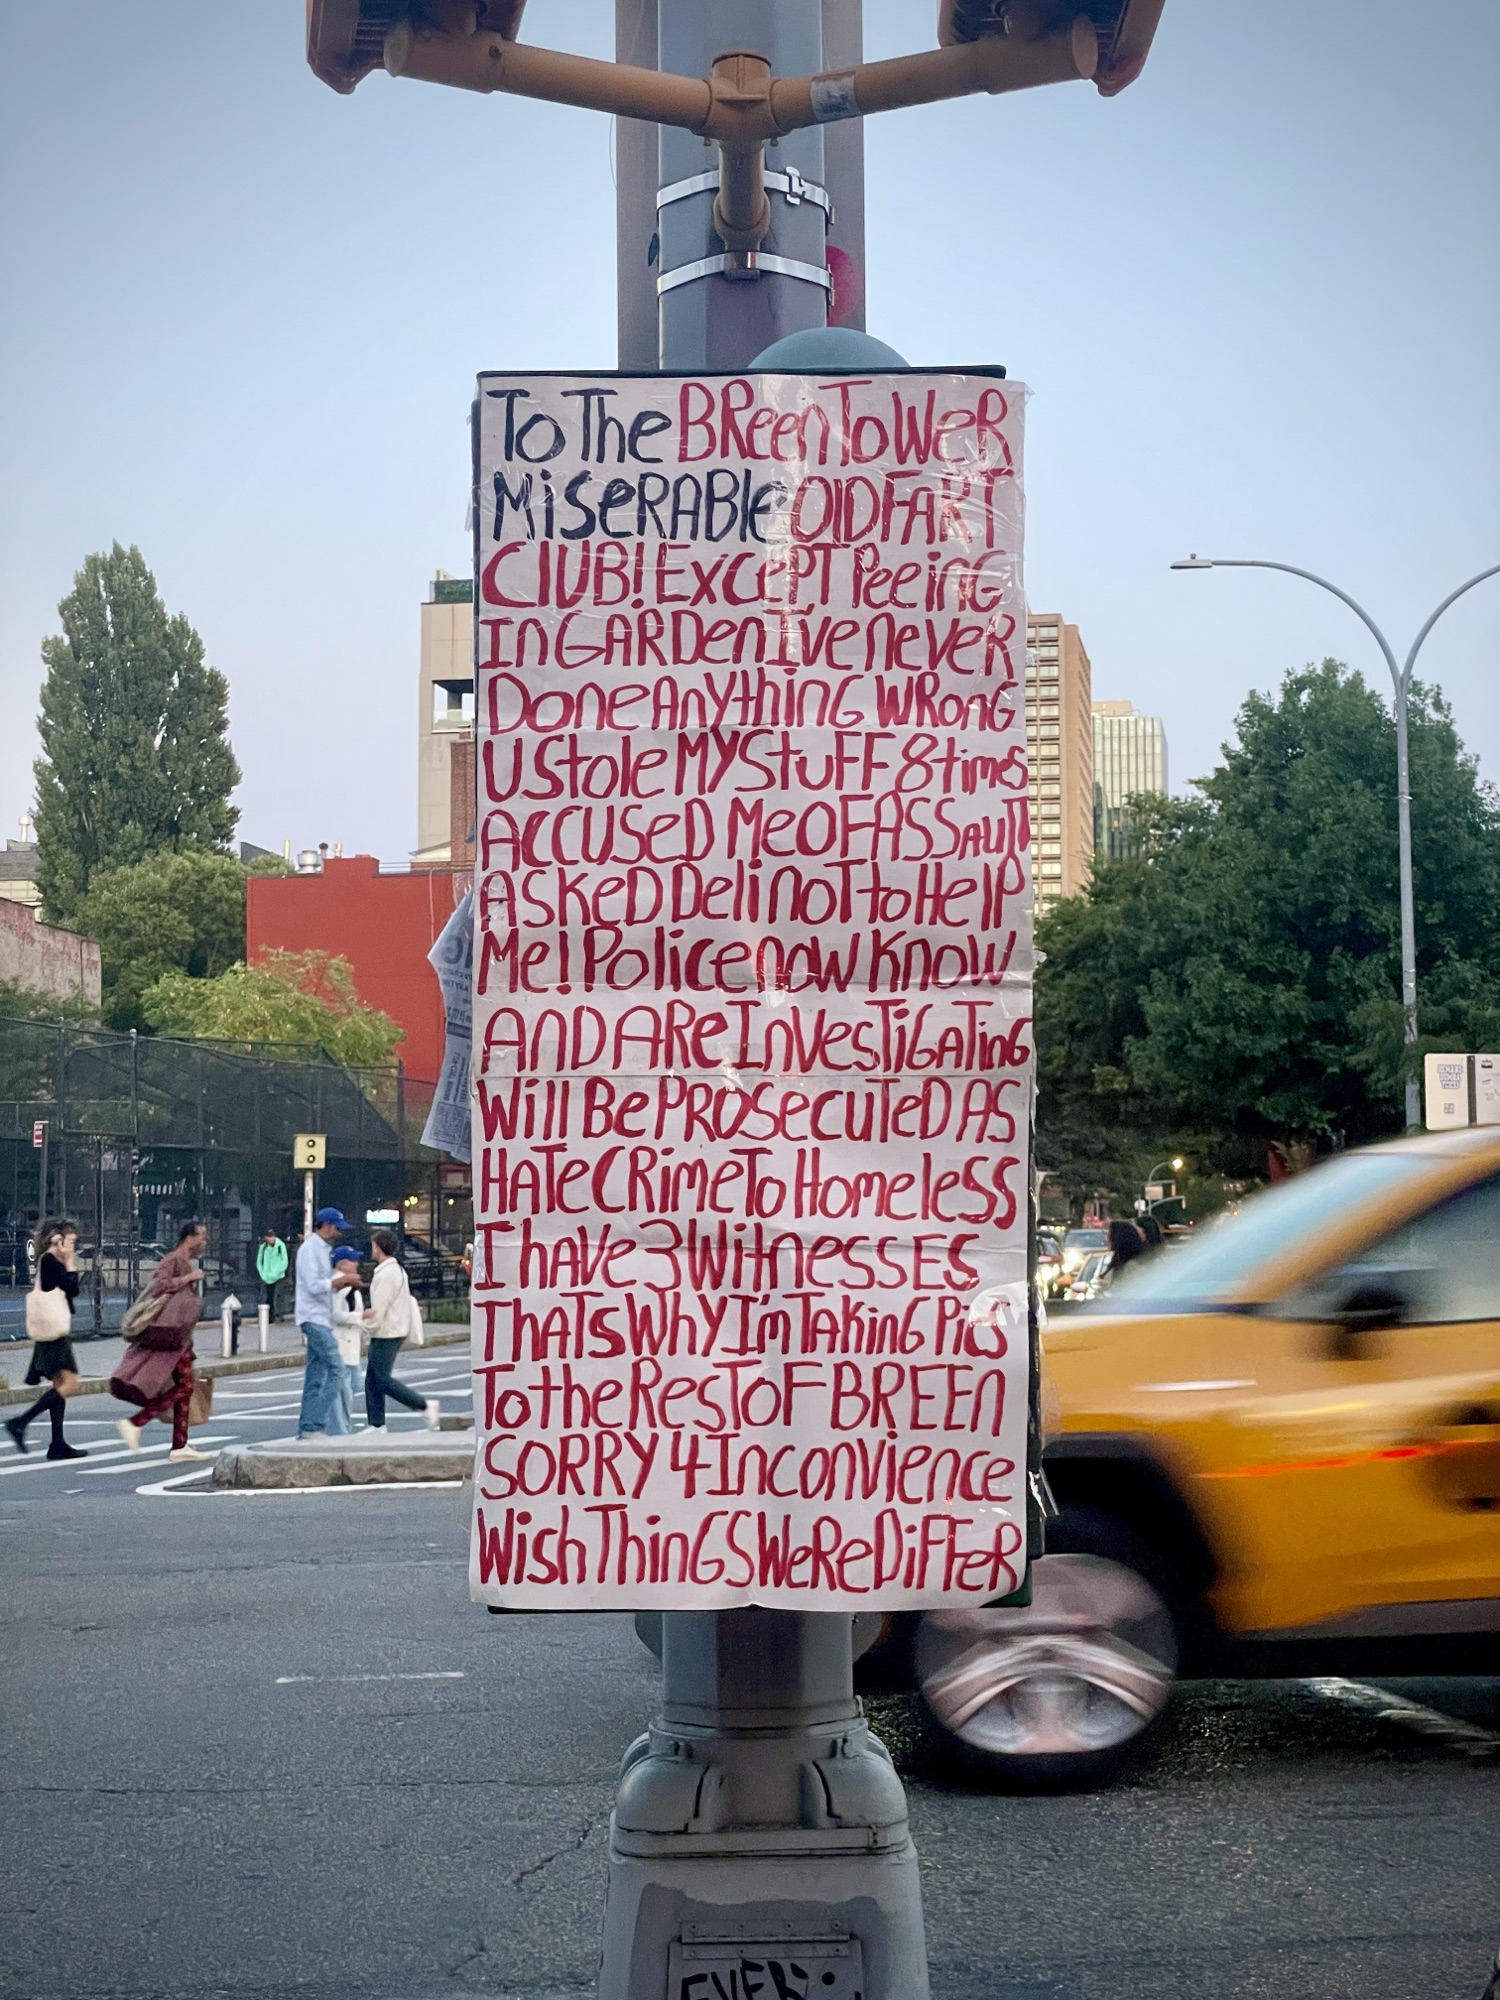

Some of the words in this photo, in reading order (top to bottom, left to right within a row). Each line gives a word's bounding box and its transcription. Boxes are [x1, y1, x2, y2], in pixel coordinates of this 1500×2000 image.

[486, 388, 566, 463] To
[561, 388, 672, 463] The
[479, 617, 548, 668] In
[483, 738, 523, 802] U
[896, 733, 938, 792] 8
[727, 796, 798, 860] Me
[672, 858, 760, 923] Deli
[477, 926, 571, 995] Me!
[583, 1076, 650, 1138] Be
[730, 1146, 786, 1216] To
[474, 1221, 515, 1290] I
[638, 1219, 683, 1292] 3
[722, 1294, 791, 1355] I'm
[473, 1362, 532, 1429] To
[671, 1430, 711, 1498] 4
